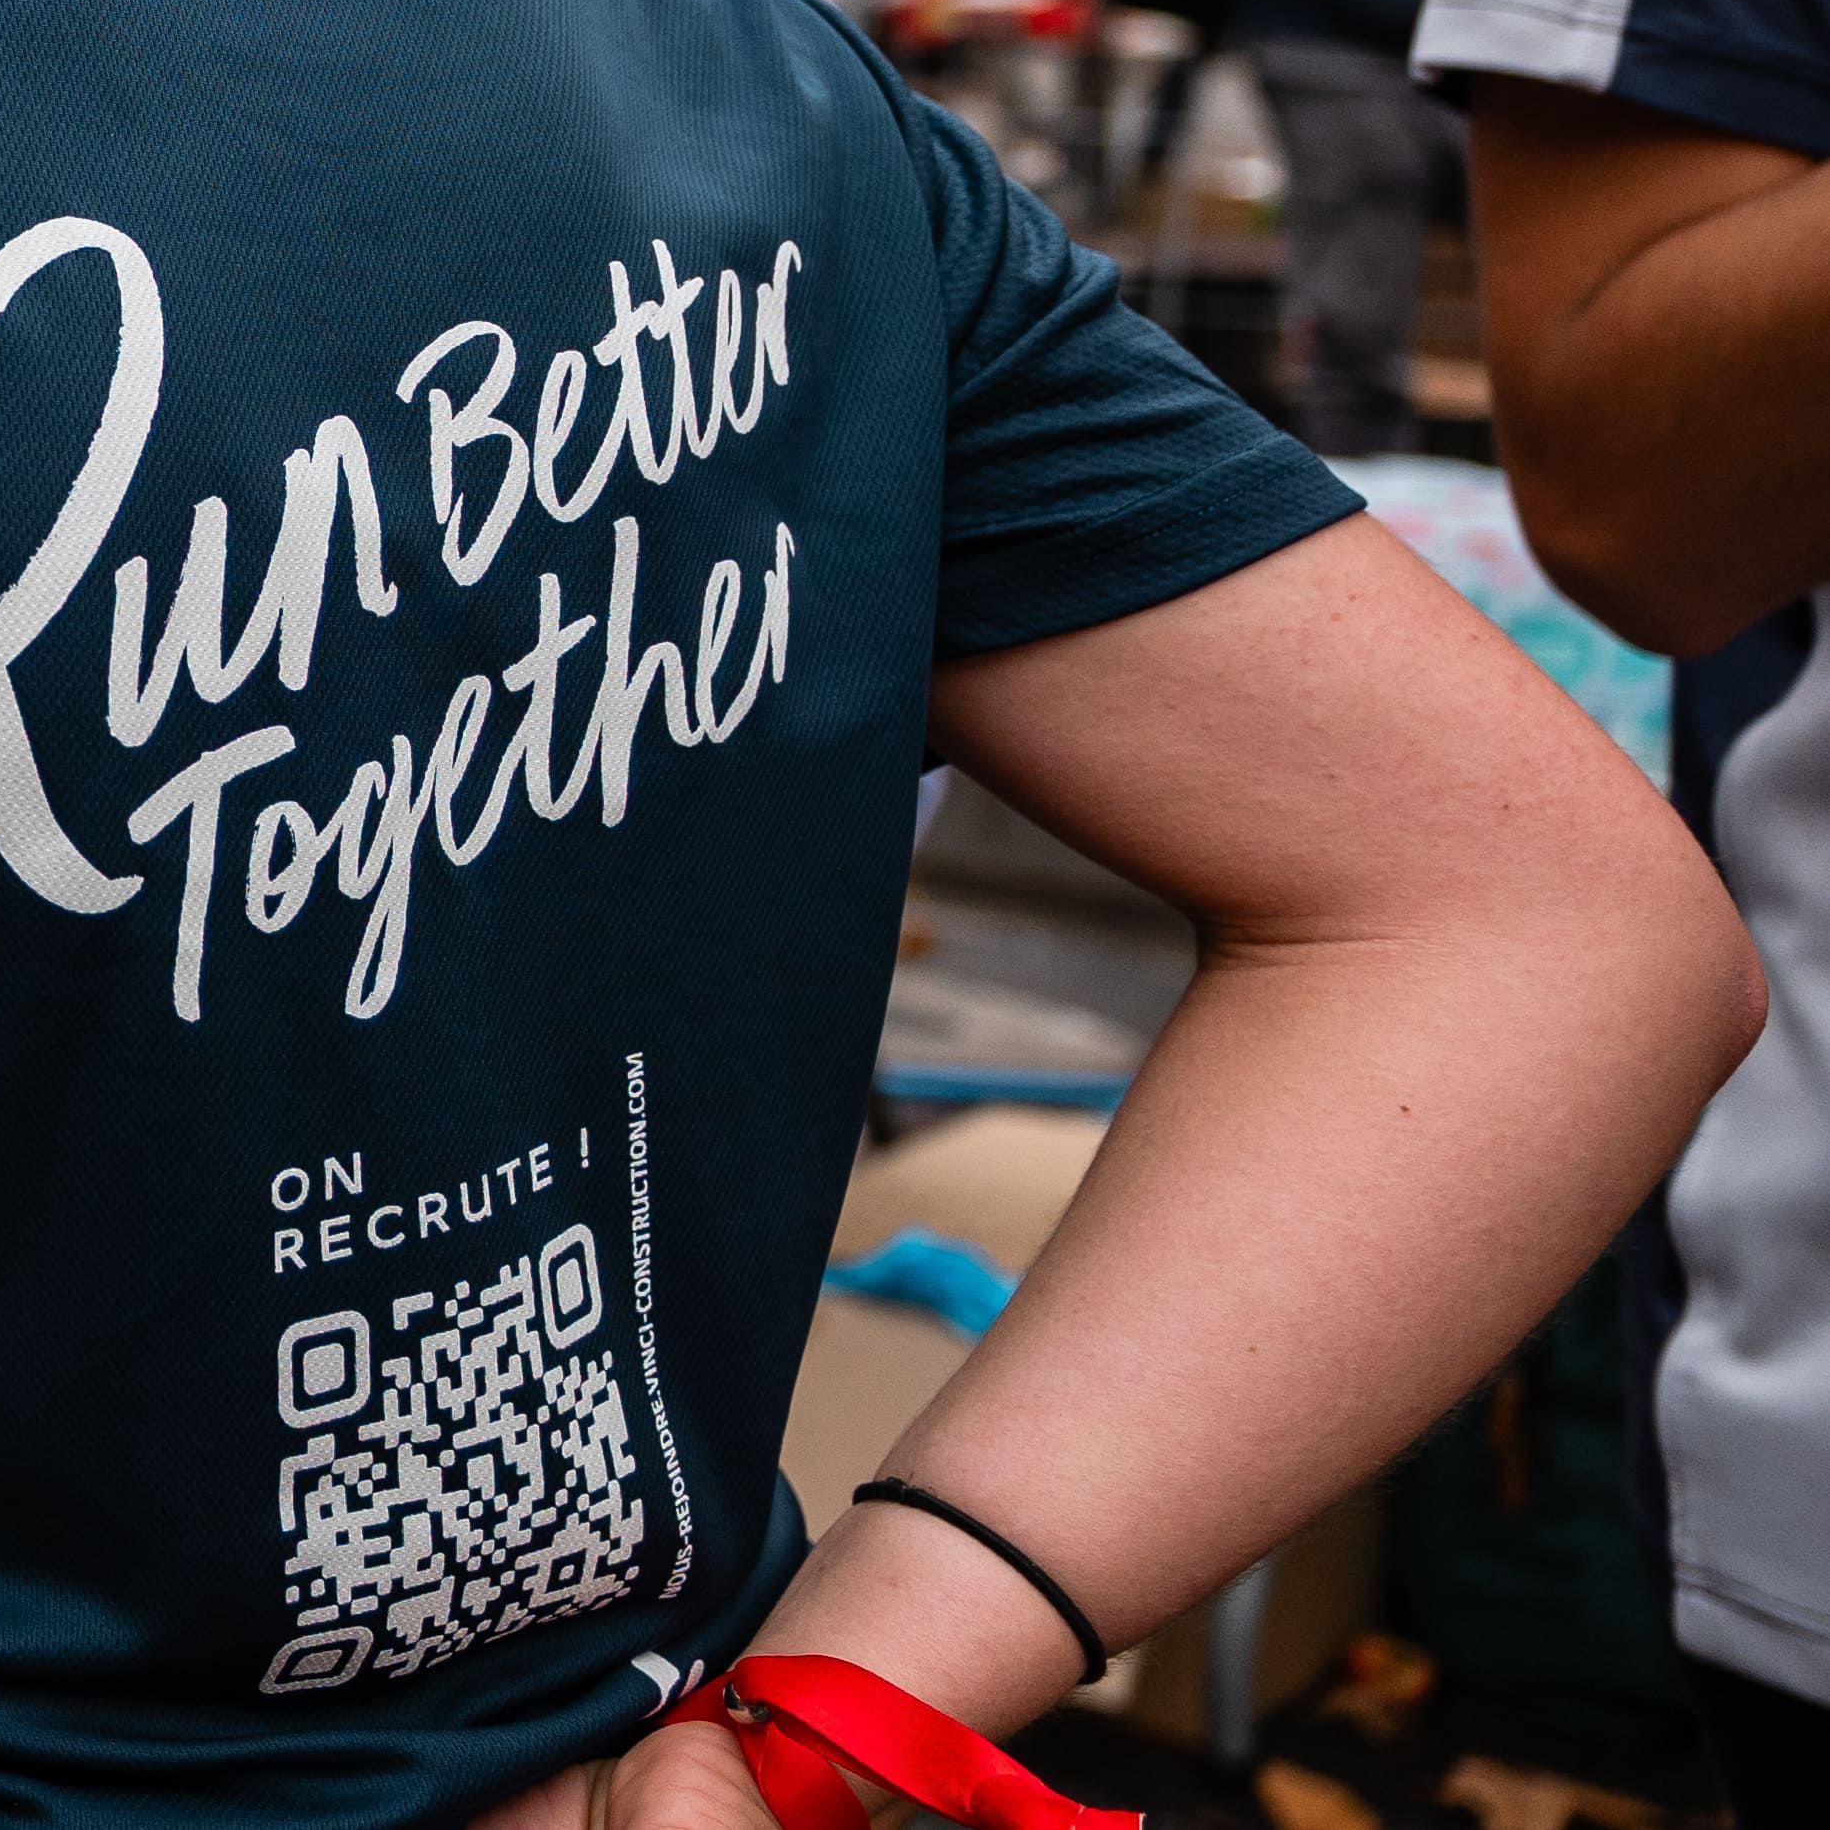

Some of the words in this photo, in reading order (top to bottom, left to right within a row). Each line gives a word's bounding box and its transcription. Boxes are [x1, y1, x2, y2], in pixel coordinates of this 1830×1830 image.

[395, 238, 802, 587] Better
[127, 516, 796, 1023] Together
[271, 1151, 364, 1212] ON
[274, 1143, 554, 1274] RECRUTE
[579, 1127, 590, 1169] !
[625, 1050, 693, 1601] NOUS-REJOINDRE.VINCI-CONSTRUCTION.COM
